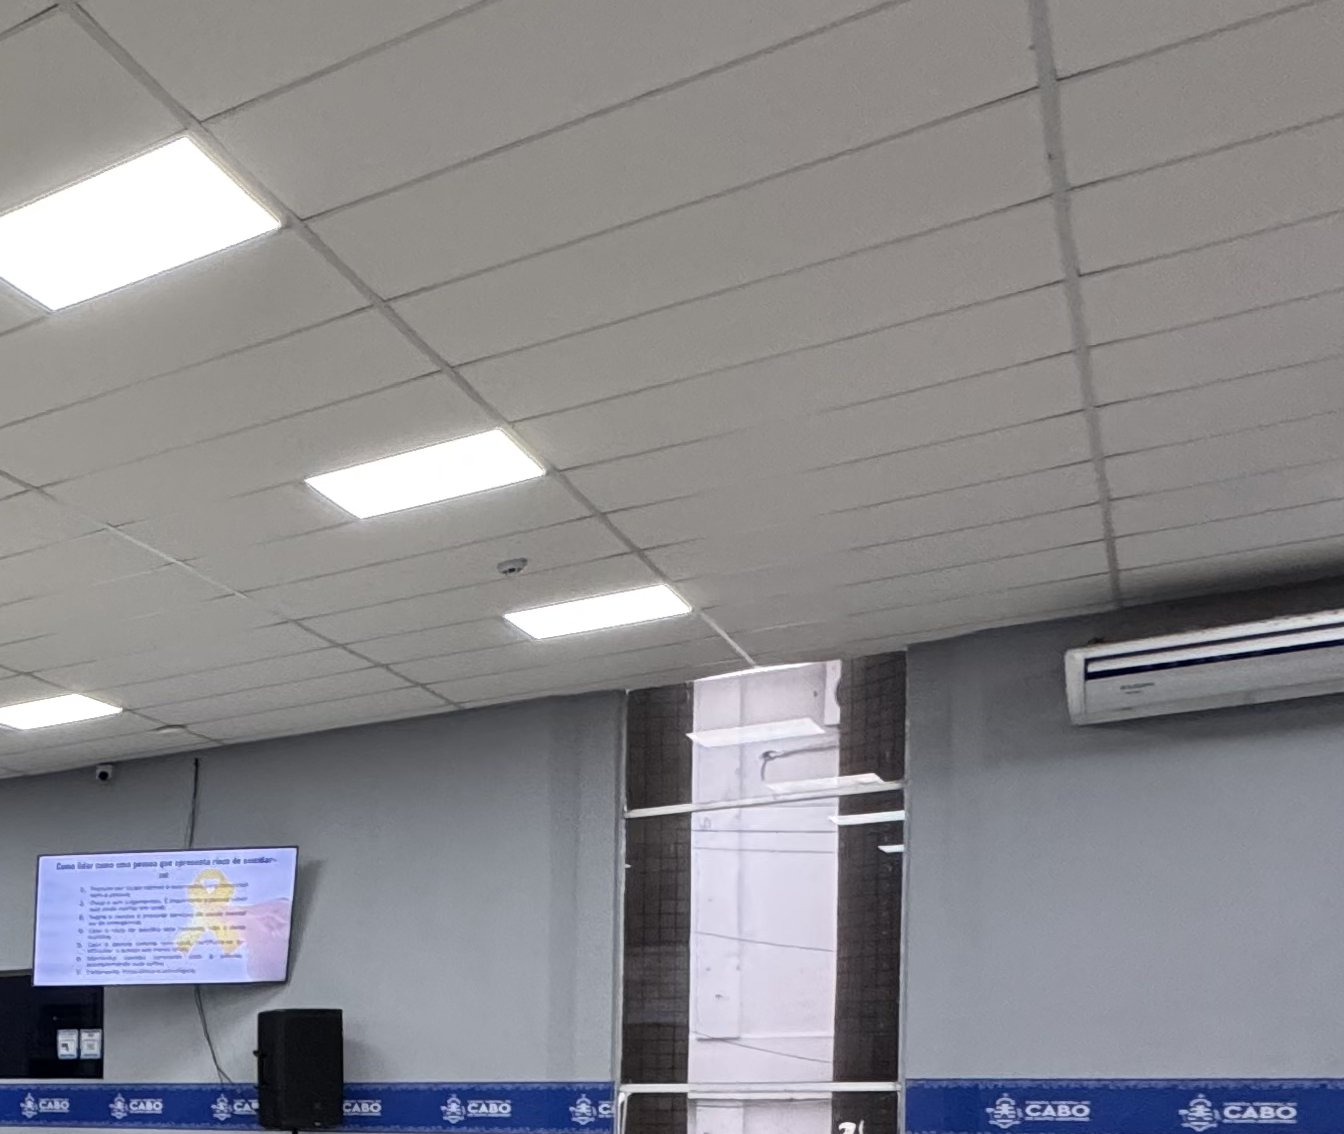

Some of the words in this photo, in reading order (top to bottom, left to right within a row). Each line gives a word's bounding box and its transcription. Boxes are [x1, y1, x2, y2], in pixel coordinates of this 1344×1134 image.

[38, 1100, 70, 1110] CABO
[129, 1101, 163, 1111] CABO
[342, 1103, 382, 1113] CABO
[467, 1103, 512, 1113] CABO
[1025, 1104, 1090, 1117] CABO
[1223, 1105, 1297, 1119] CABO
